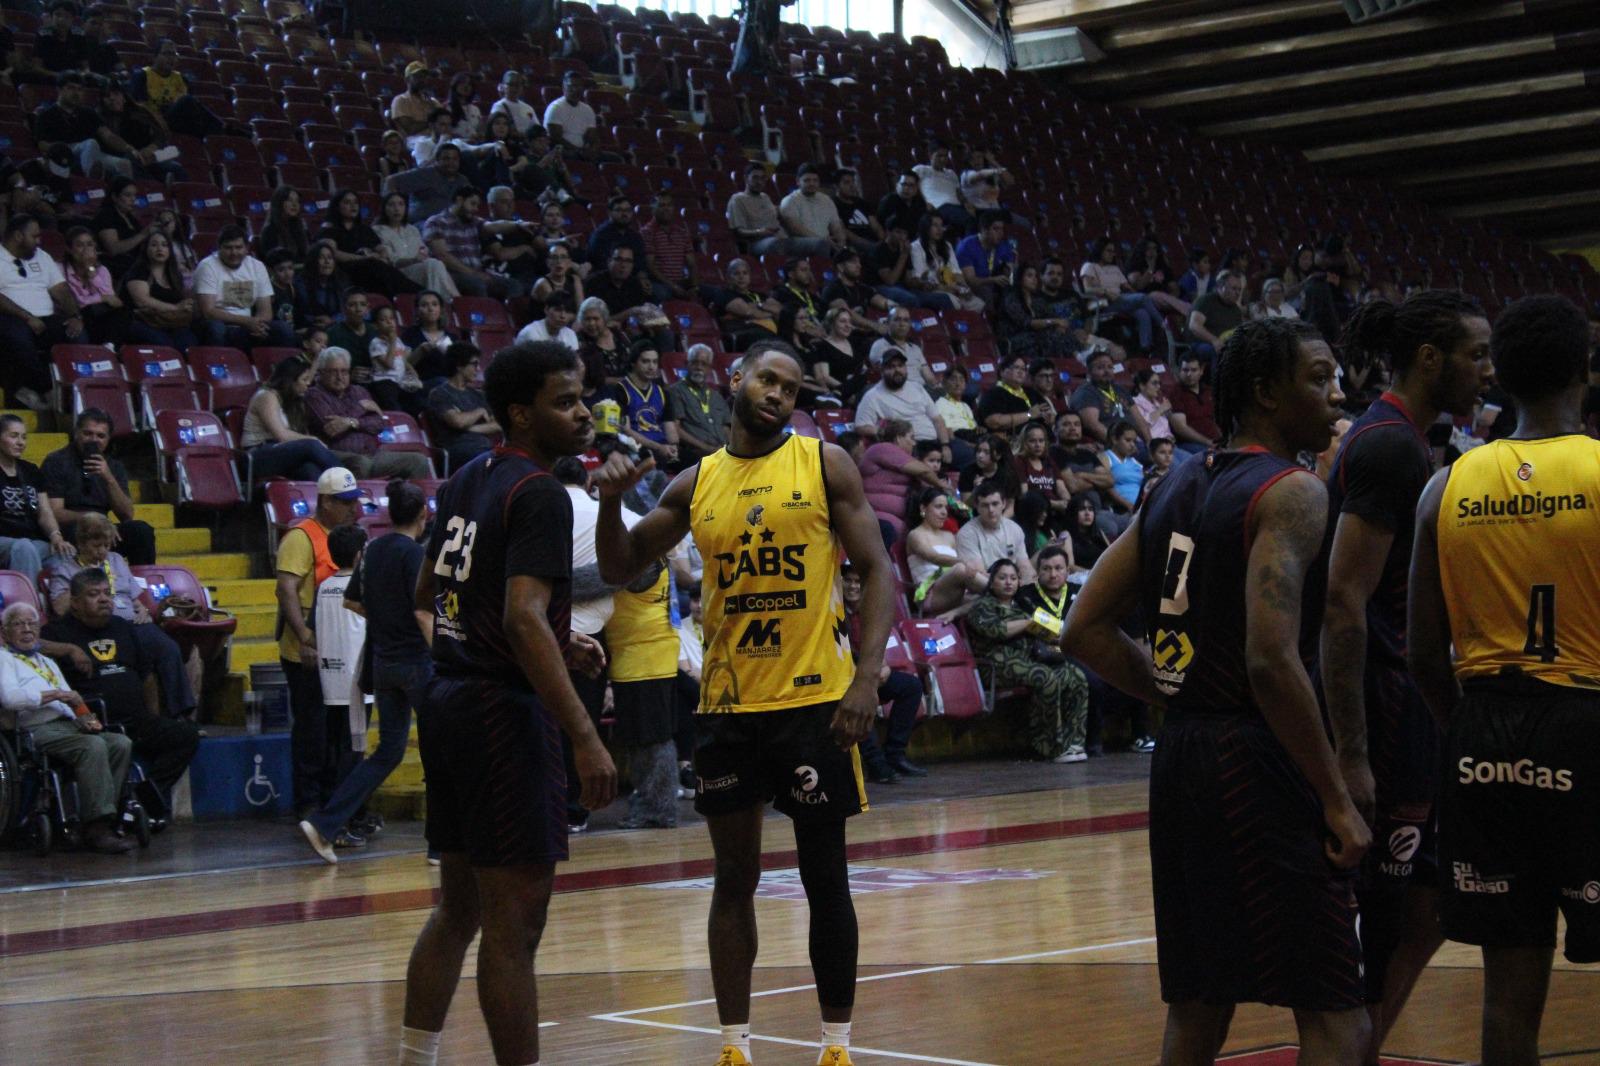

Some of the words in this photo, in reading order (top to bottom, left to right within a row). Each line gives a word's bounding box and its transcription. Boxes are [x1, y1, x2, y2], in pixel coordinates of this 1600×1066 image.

[737, 486, 773, 496] VENTO
[1457, 491, 1587, 519] SaludDigna
[434, 515, 477, 582] 23
[713, 544, 808, 589] CABS
[745, 594, 800, 609] Coppel
[1524, 584, 1559, 662] 4
[1458, 756, 1574, 792] SonGas
[790, 787, 829, 804] MEGA
